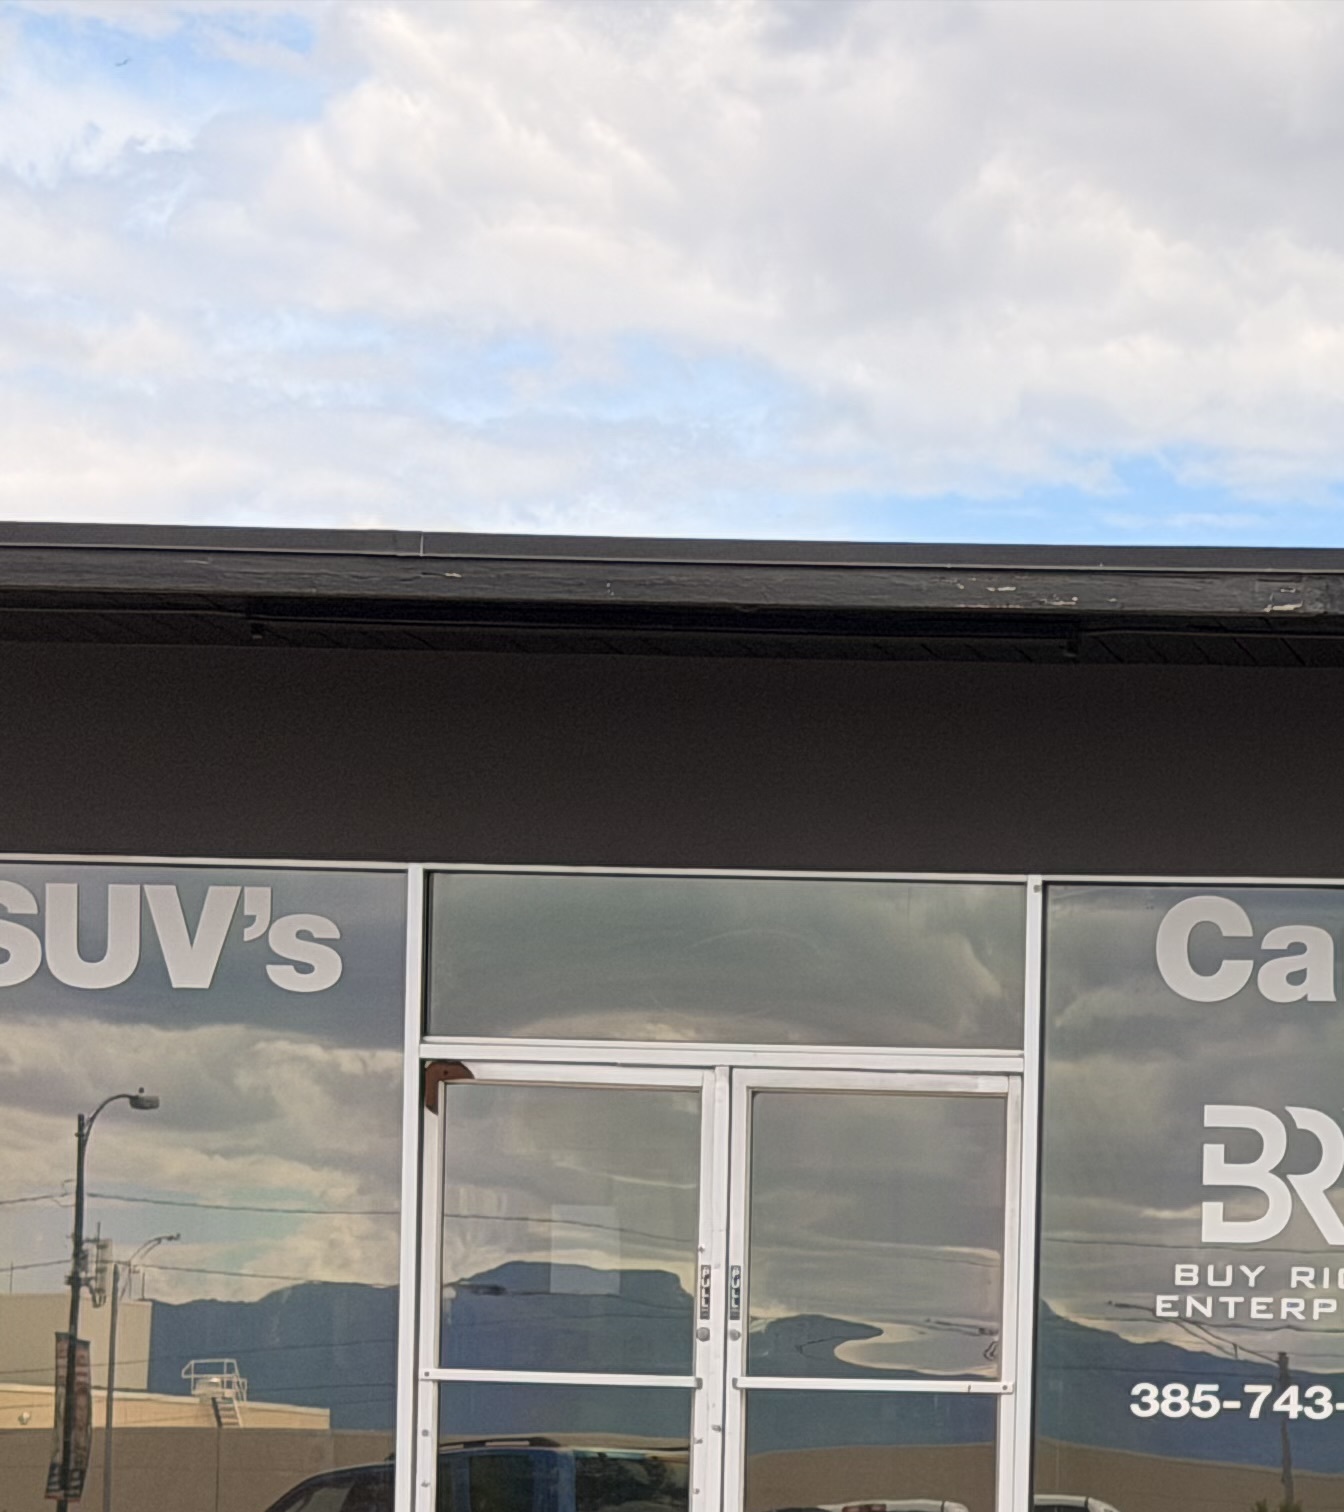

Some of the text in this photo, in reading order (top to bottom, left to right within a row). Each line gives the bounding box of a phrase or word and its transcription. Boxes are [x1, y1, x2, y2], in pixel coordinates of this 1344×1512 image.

[701, 1267, 710, 1308] PULL
[731, 1267, 741, 1309] PULL
[1174, 1264, 1266, 1287] BUY
